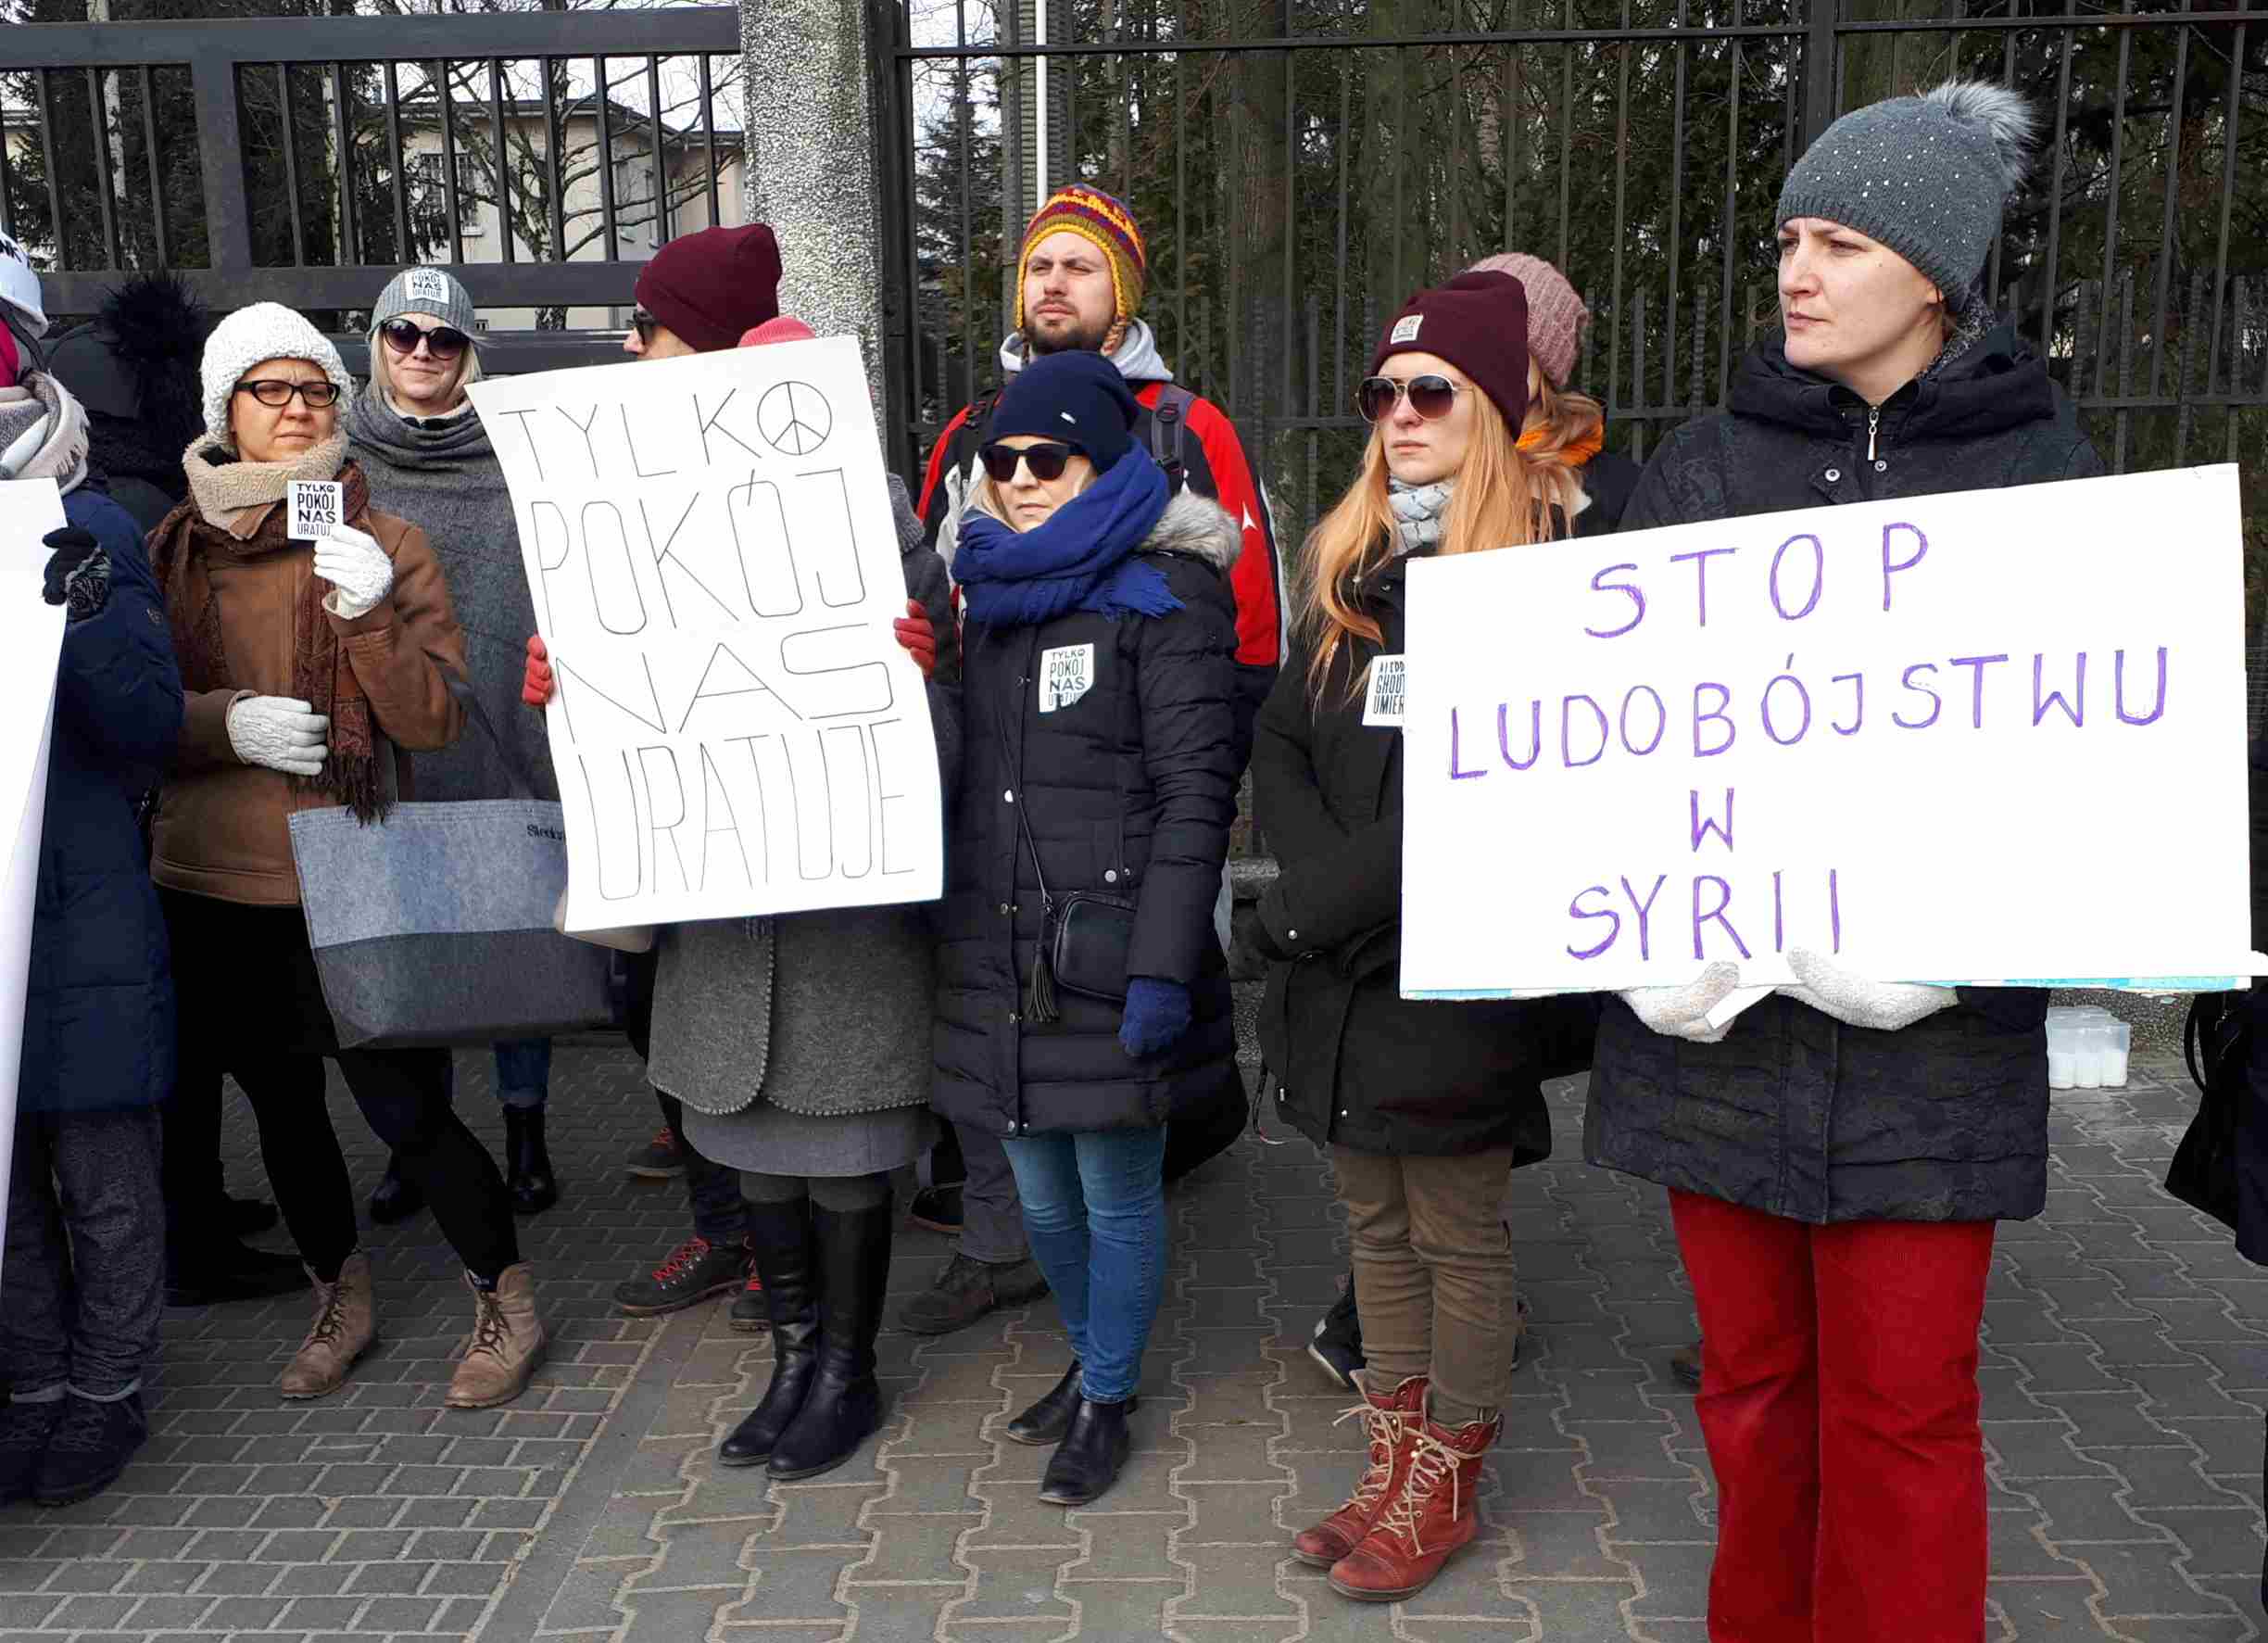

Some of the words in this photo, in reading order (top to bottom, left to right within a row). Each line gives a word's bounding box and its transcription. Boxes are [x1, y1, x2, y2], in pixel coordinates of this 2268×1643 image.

[297, 523, 333, 537] URATUJ
[298, 510, 336, 524] NAS
[531, 466, 866, 638] POKÓJ
[1584, 521, 1930, 638] STOP
[554, 622, 894, 746] NAS
[1049, 676, 1086, 693] NAS
[1447, 645, 2170, 780] LUDOBÓJSTWU
[577, 717, 915, 902] URATUJE
[1690, 787, 1736, 853] W
[1566, 867, 1841, 962] SYRII
